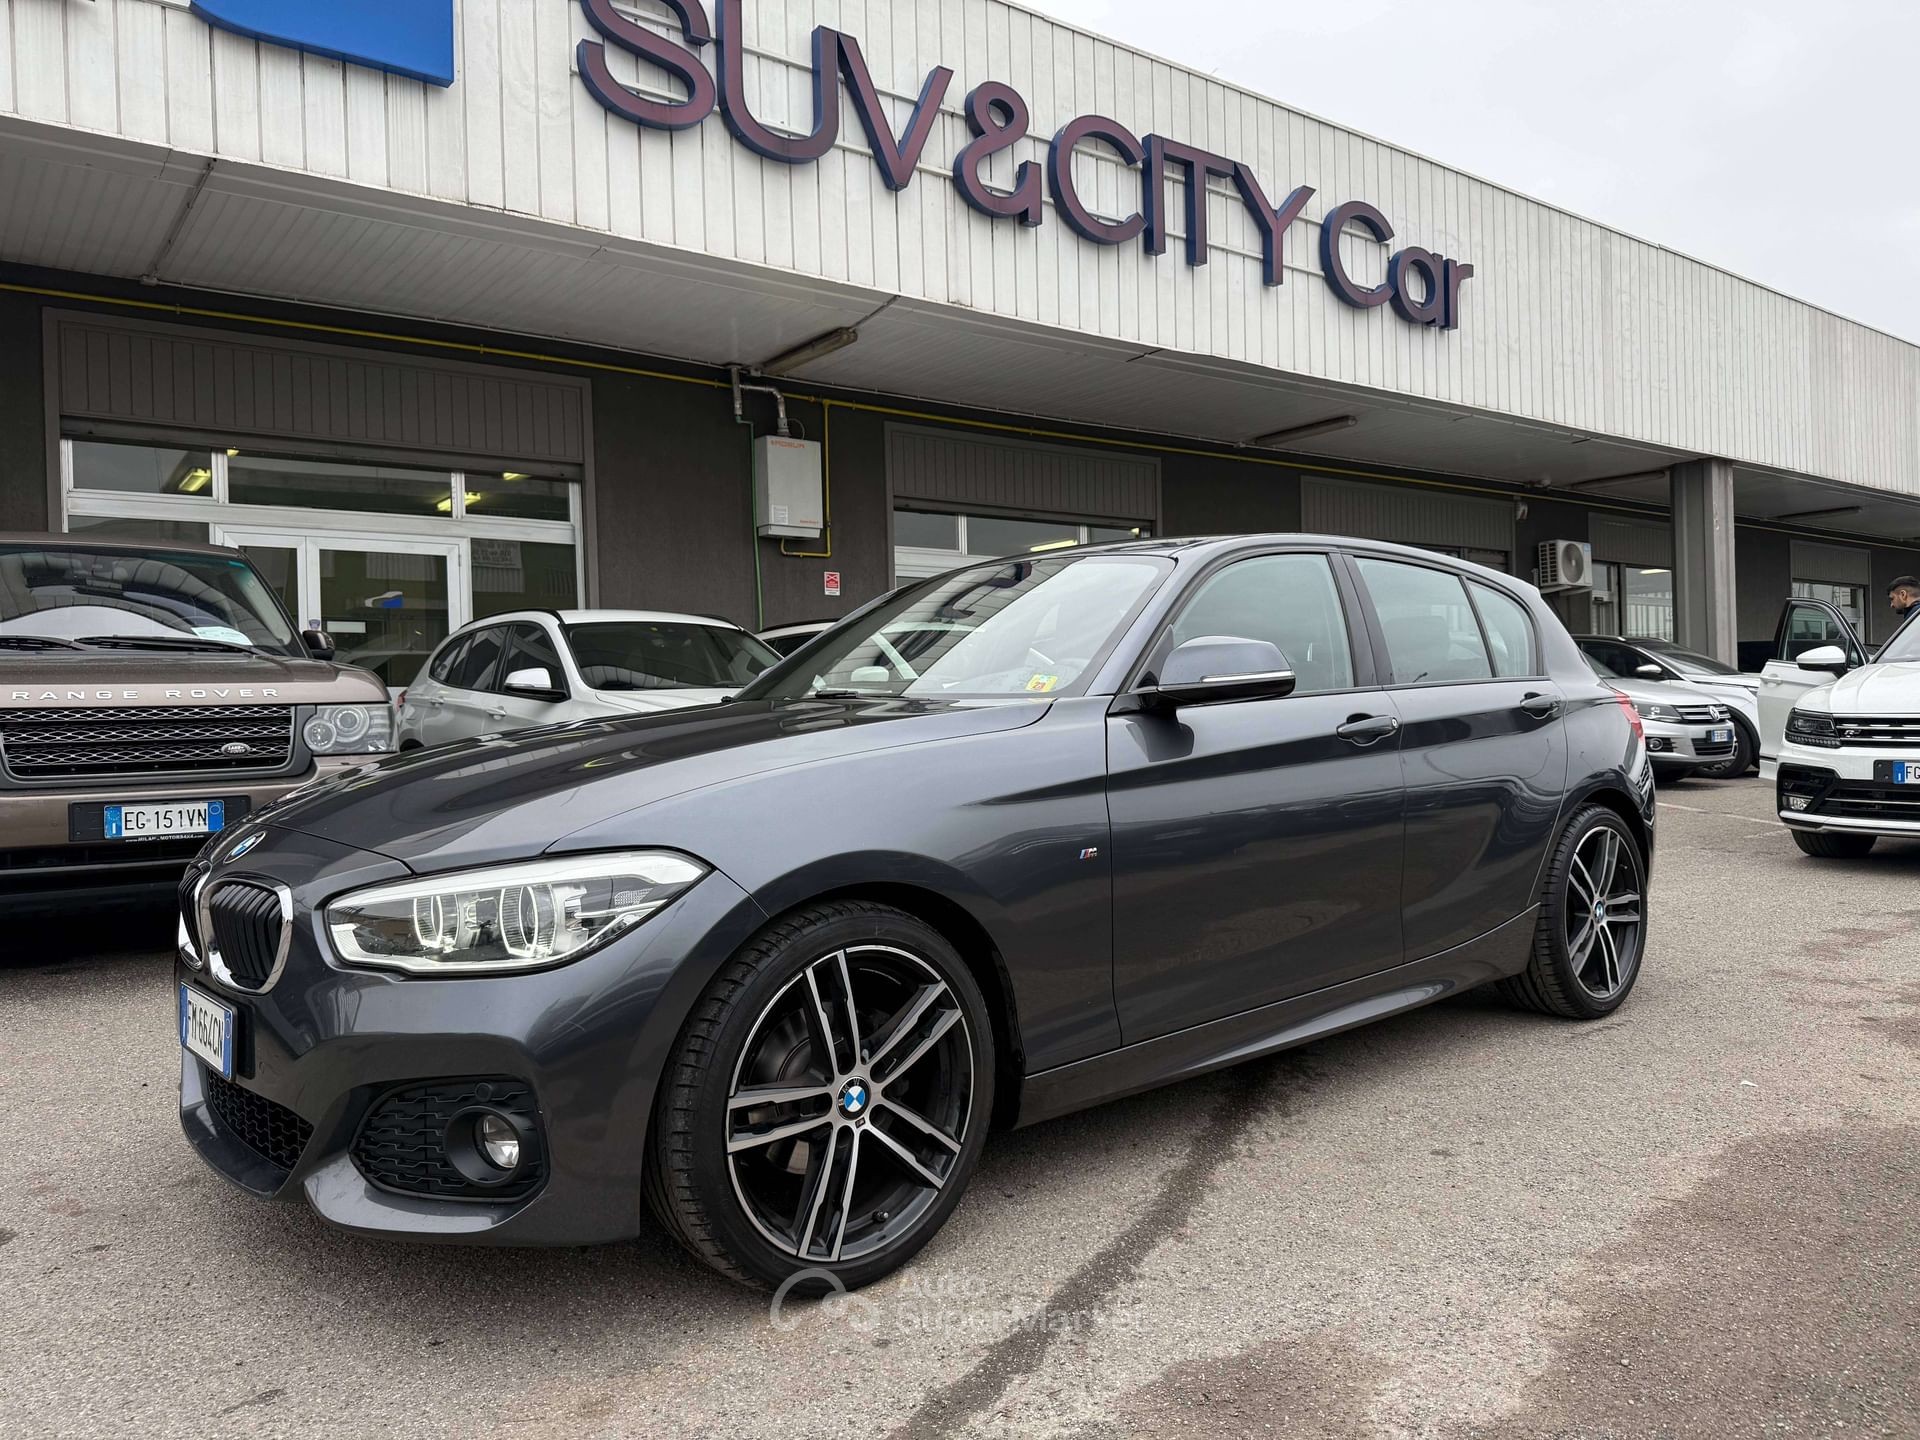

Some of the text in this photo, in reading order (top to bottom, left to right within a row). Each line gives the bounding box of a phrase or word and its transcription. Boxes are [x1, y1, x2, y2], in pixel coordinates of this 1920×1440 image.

[1320, 201, 1474, 330] Car
[12, 688, 279, 700] RANGE ROVER
